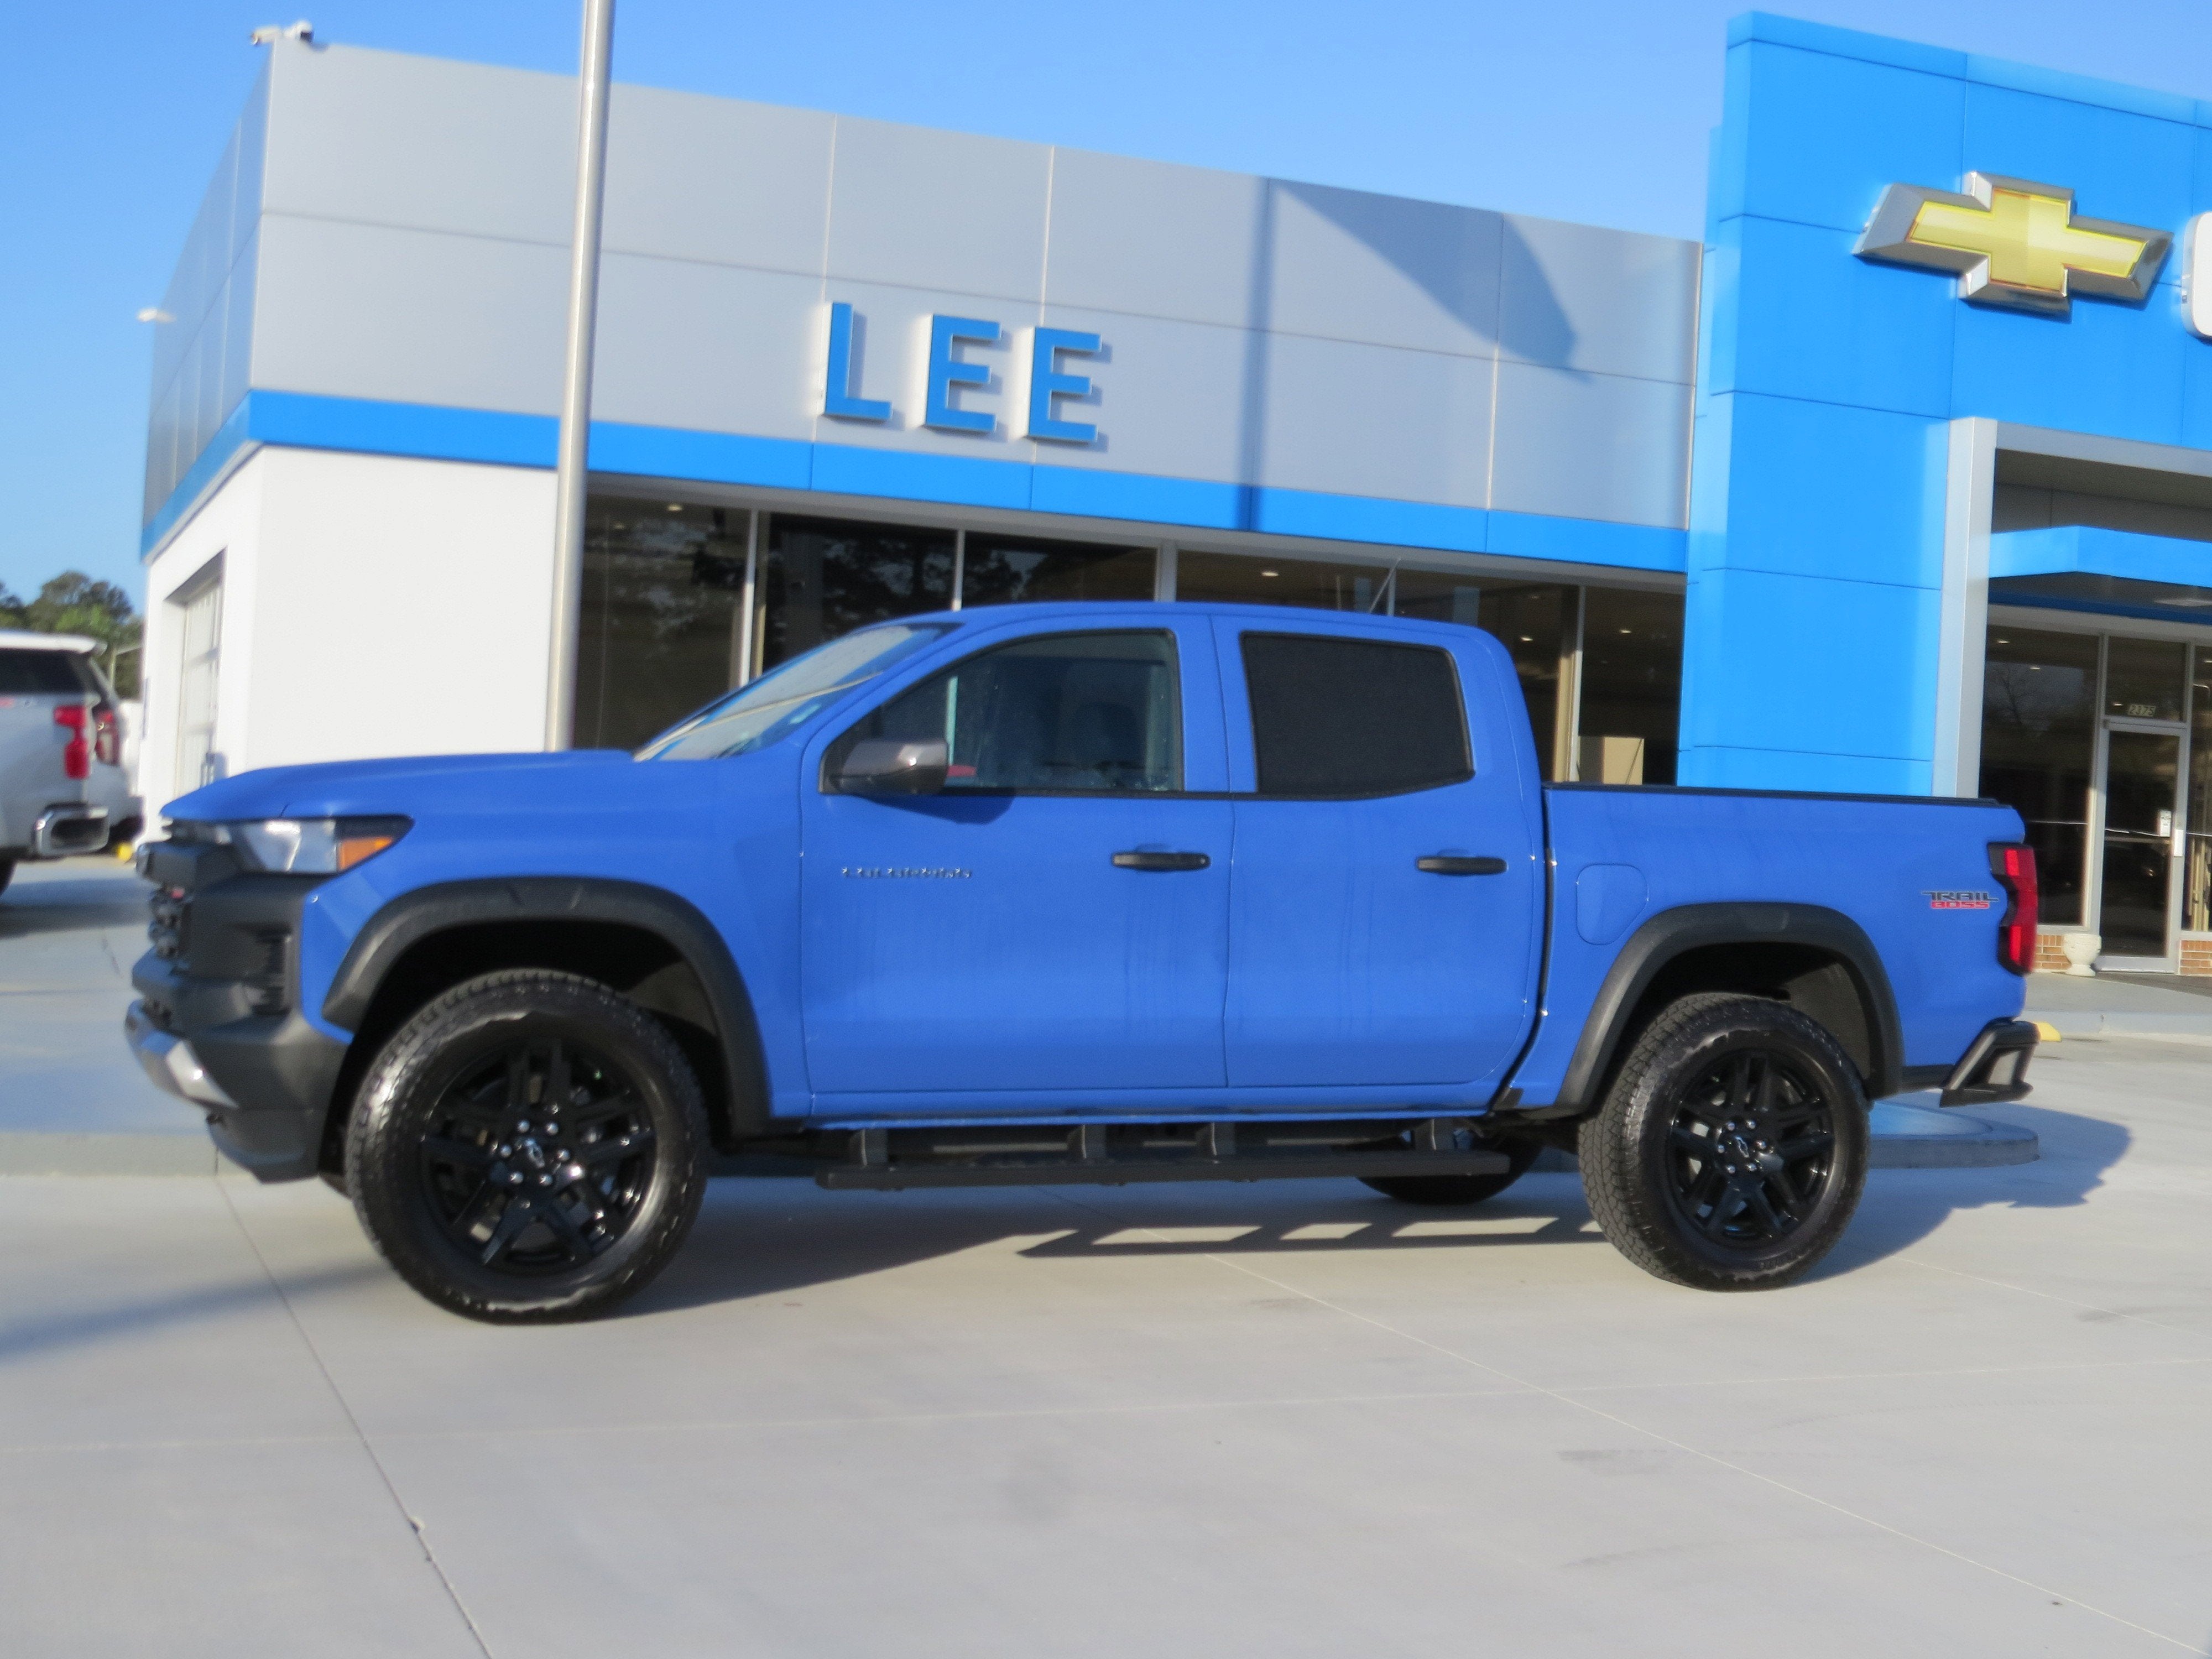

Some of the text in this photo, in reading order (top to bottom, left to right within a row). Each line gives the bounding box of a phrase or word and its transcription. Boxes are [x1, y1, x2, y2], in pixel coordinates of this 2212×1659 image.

[824, 301, 1102, 442] LEE
[1921, 891, 1999, 901] TRAIL
[1931, 900, 1990, 909] BOSS
